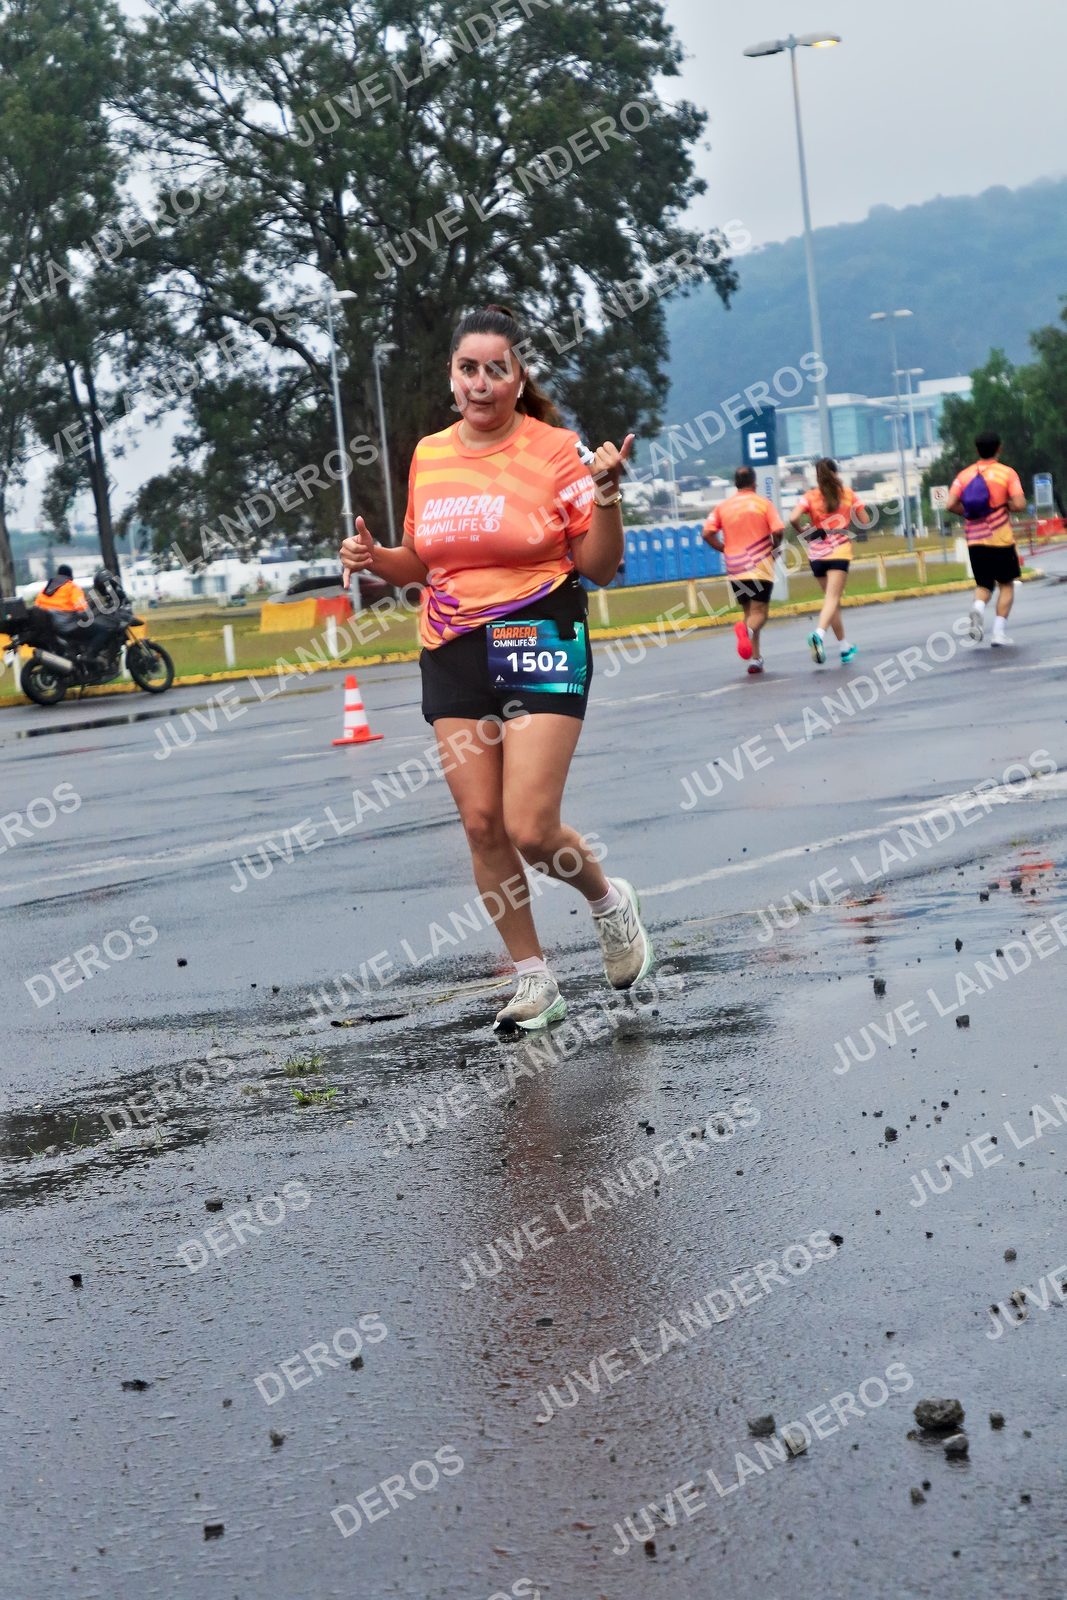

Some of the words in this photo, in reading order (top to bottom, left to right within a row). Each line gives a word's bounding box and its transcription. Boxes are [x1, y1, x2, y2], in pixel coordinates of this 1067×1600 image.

[747, 431, 768, 460] E
[422, 495, 506, 521] CARRERA
[416, 518, 479, 537] OMNILIFE
[492, 626, 538, 640] CARRERA
[493, 639, 528, 648] OMNILIFE
[506, 650, 569, 673] 1502
